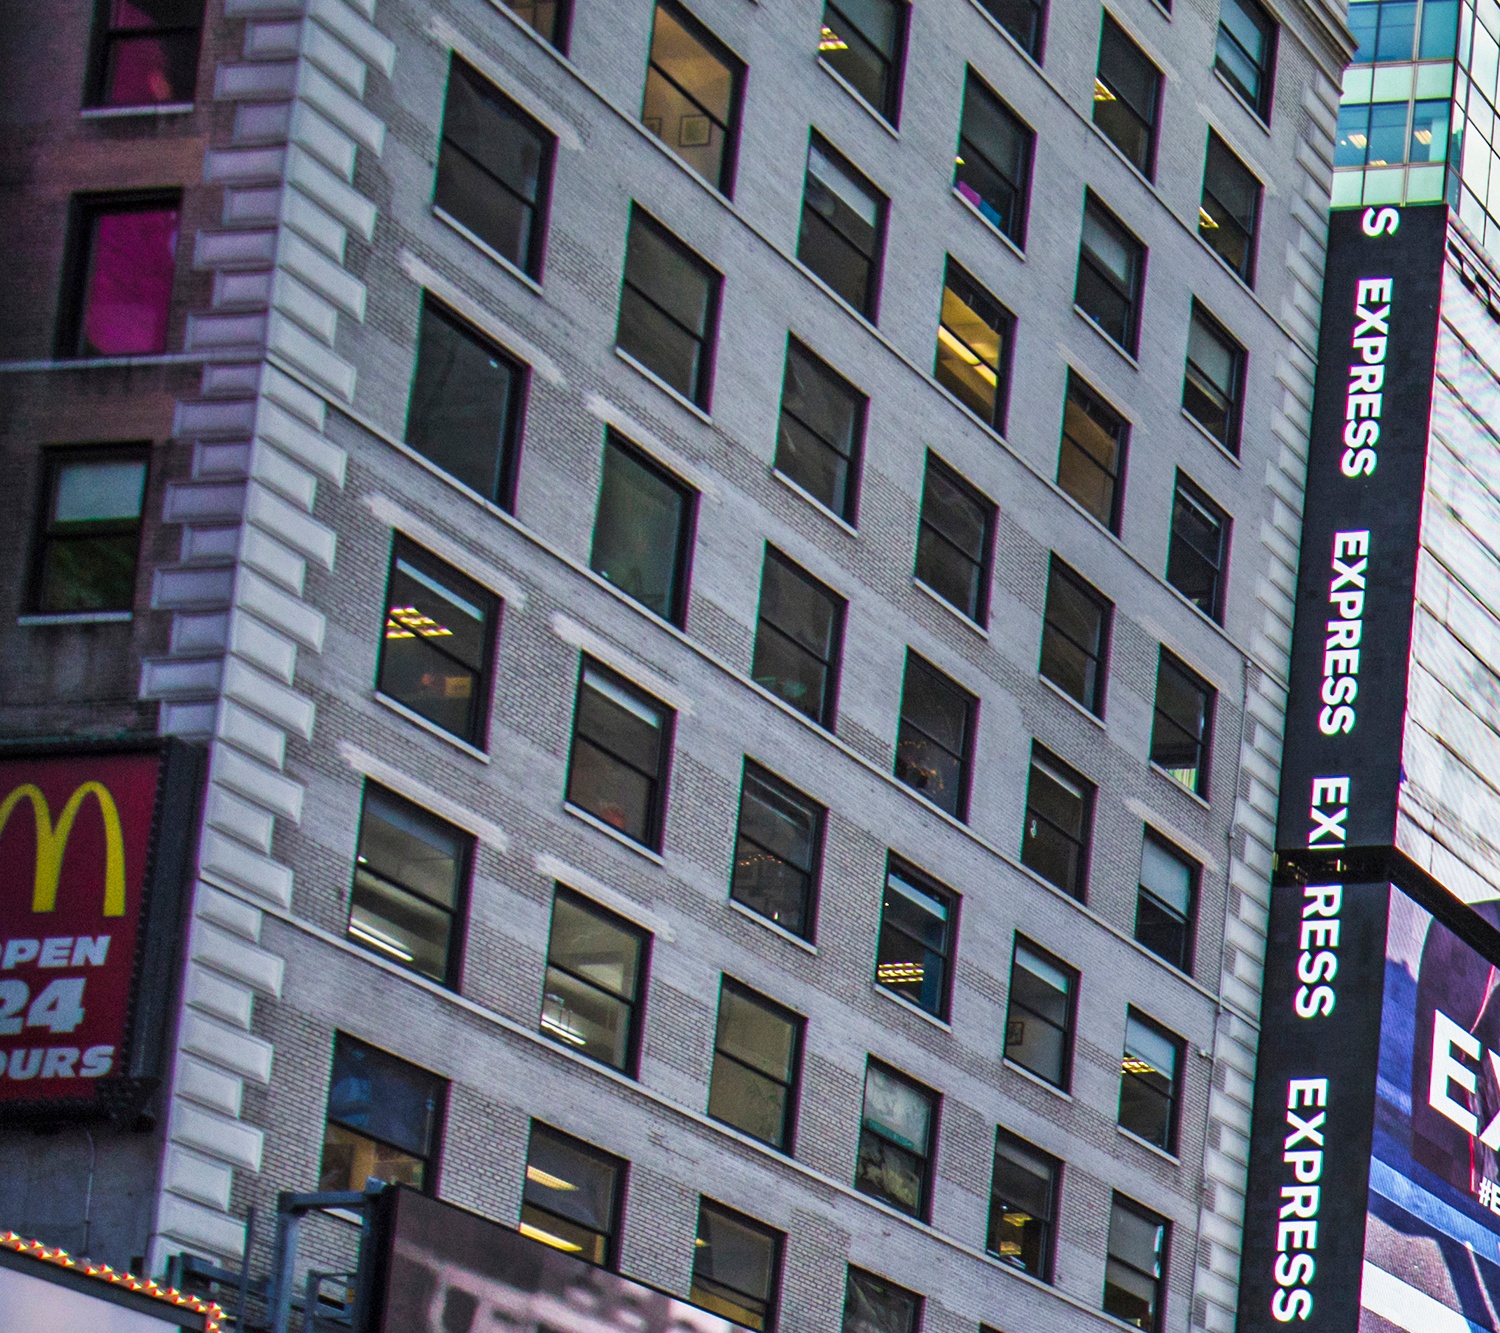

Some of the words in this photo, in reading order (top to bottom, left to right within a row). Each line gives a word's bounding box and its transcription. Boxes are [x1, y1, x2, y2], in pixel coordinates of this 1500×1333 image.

[1341, 277, 1391, 478] EXPRESS
[1319, 529, 1369, 736] EXPRESS
[1272, 1077, 1328, 1323] EXPRESS
